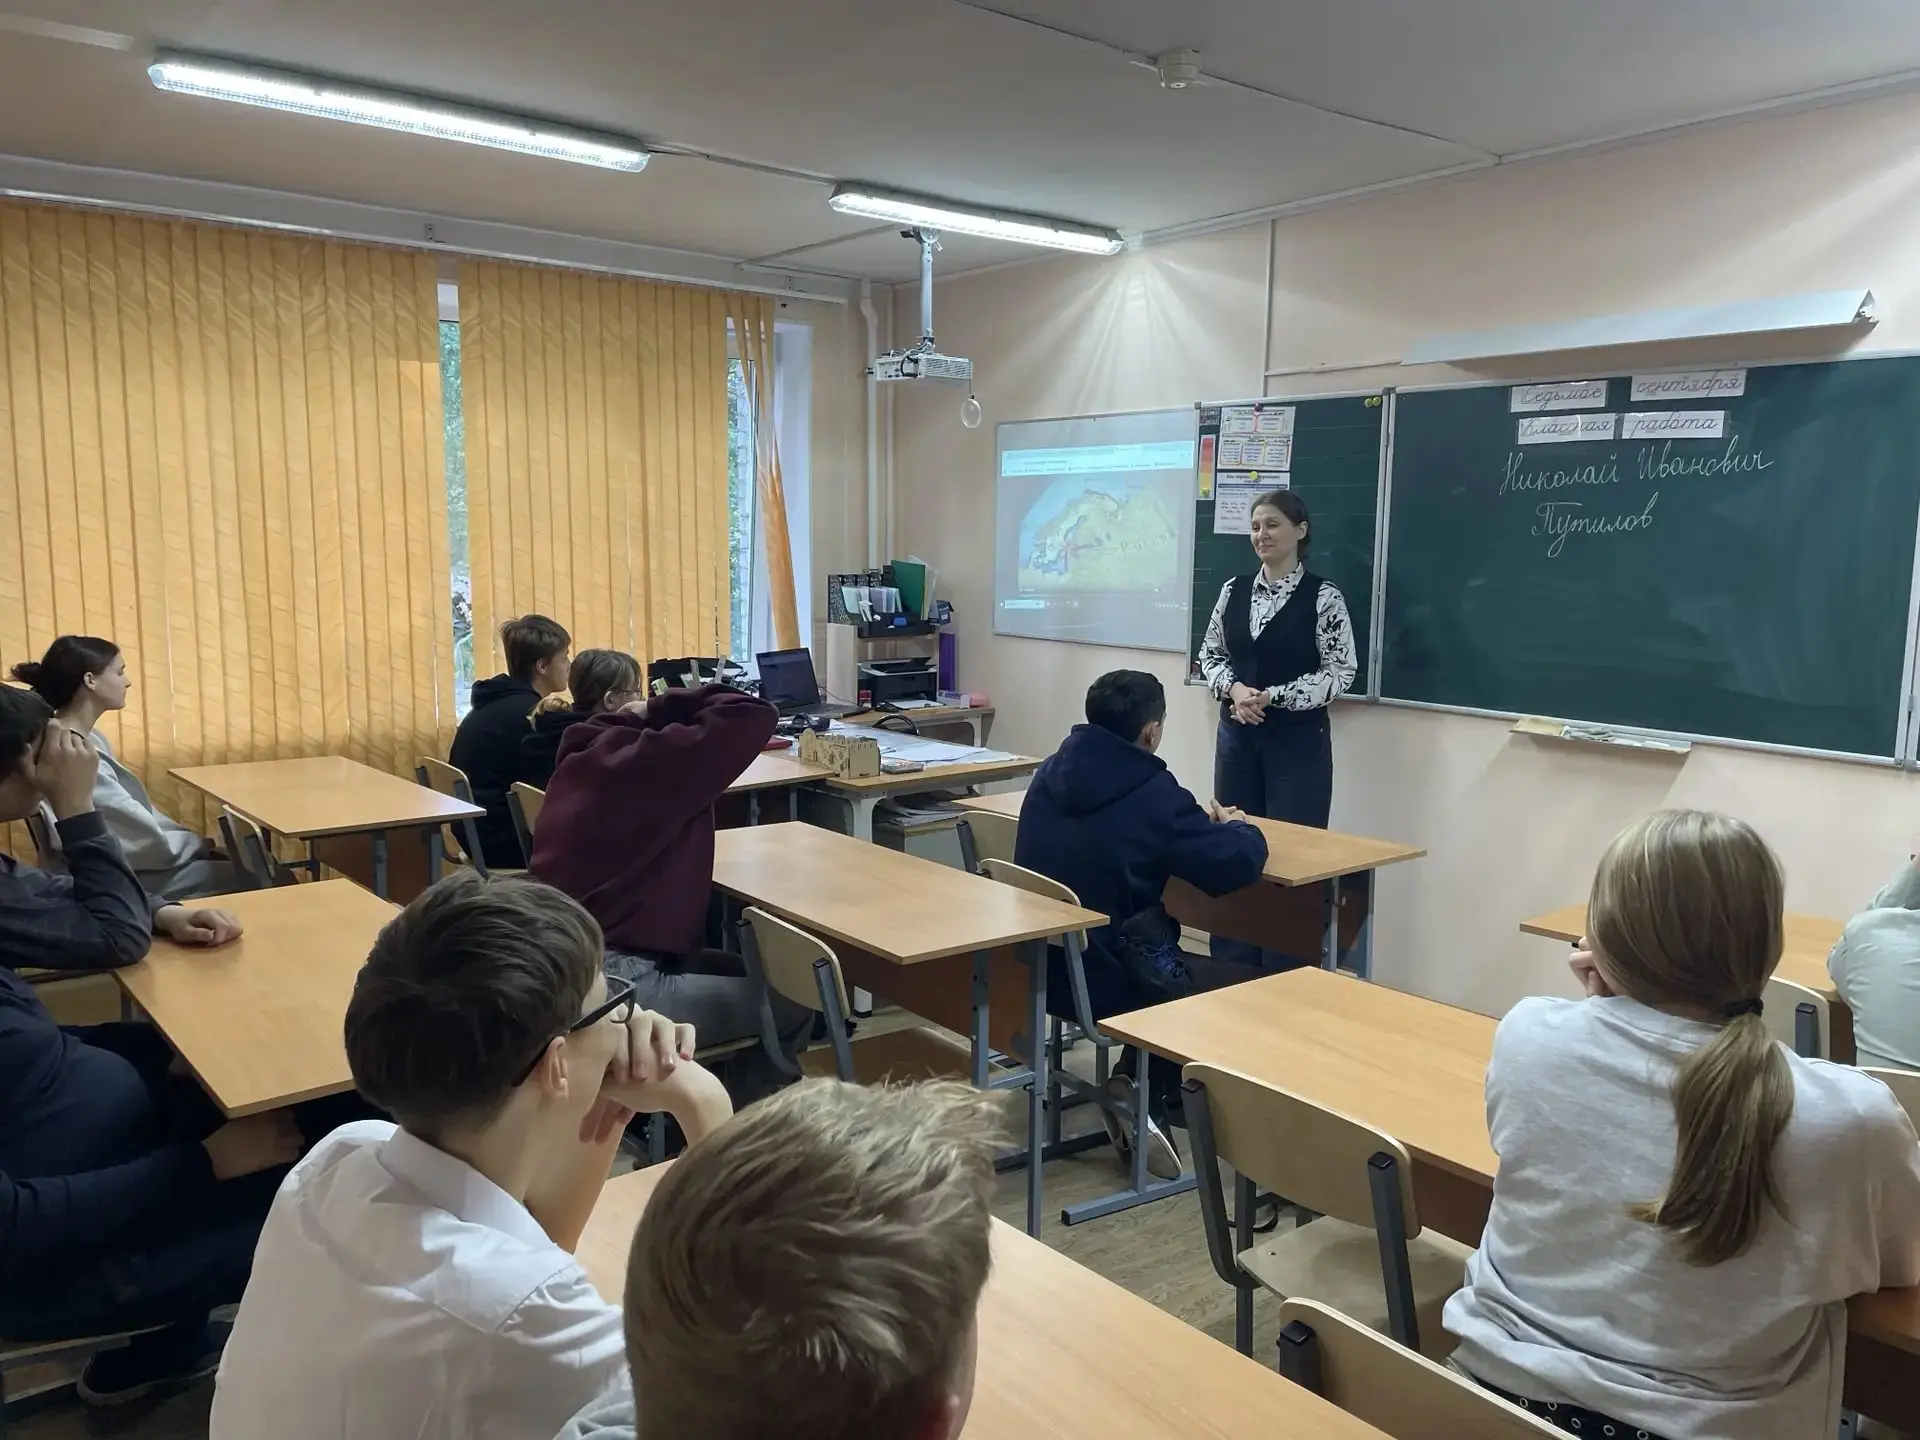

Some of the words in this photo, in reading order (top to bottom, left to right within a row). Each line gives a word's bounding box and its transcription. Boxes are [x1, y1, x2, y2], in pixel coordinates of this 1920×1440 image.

[1637, 372, 1743, 397] сентября
[1520, 419, 1613, 437] Классная
[1629, 411, 1718, 439] работа
[1500, 452, 1619, 495] Николай
[1638, 435, 1773, 480] Иванович
[1531, 492, 1659, 558] Путилов
